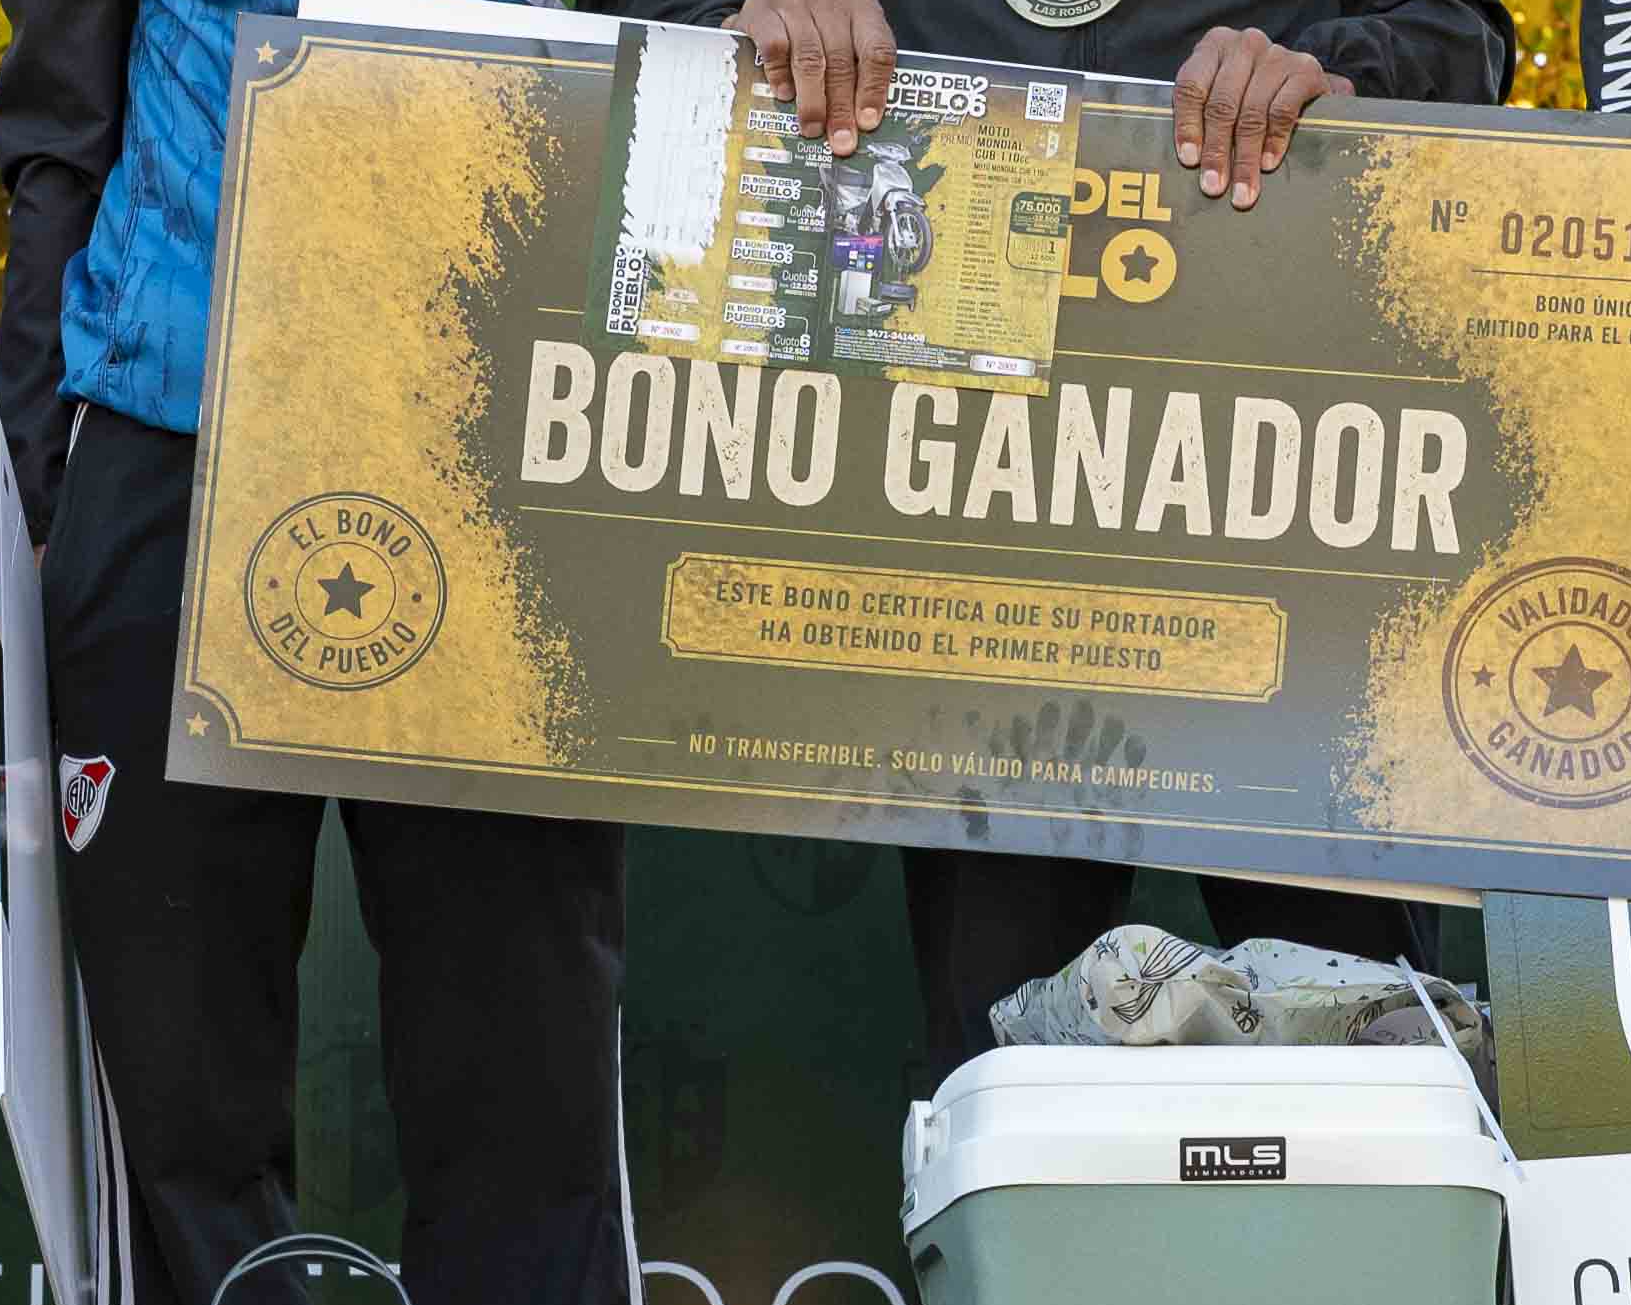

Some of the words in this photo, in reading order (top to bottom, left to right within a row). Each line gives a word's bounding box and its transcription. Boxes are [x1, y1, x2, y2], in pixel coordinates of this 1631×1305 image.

[1034, 3, 1057, 16] LAS
[1059, 1, 1100, 17] ROSAS
[885, 87, 969, 111] UEBLO
[941, 77, 971, 91] DEL
[1070, 167, 1172, 222] DEL
[620, 258, 642, 332] PUEBLO
[1535, 295, 1585, 314] BONO
[1466, 318, 1539, 339] EMITIDO
[1547, 322, 1594, 343] PARA
[1601, 326, 1621, 345] EL
[521, 341, 843, 509] BONO
[884, 379, 1468, 554] GANADOR
[288, 517, 325, 551] EL
[337, 508, 412, 558] BONO
[716, 580, 773, 607] ESTE
[783, 584, 851, 614] BONO
[861, 592, 984, 624] CERTIFICA
[995, 602, 1042, 628] QUE
[1050, 605, 1081, 630] SU
[1090, 609, 1217, 642] PORTADOR
[269, 612, 311, 662] DEL
[319, 622, 417, 674] PUEBLO
[760, 618, 793, 643] HA
[802, 622, 922, 654] OBTENIDO
[933, 631, 960, 656] EL
[969, 635, 1060, 665] PRIMER
[1070, 642, 1163, 673] PUESTO
[688, 733, 718, 756] NO
[725, 736, 883, 772] TRANSFERIBLE.
[891, 748, 944, 774] SOLO
[951, 750, 1023, 781] VÁLIDO
[1030, 758, 1084, 785] PARA
[1090, 764, 1223, 796] CAMPEONES.
